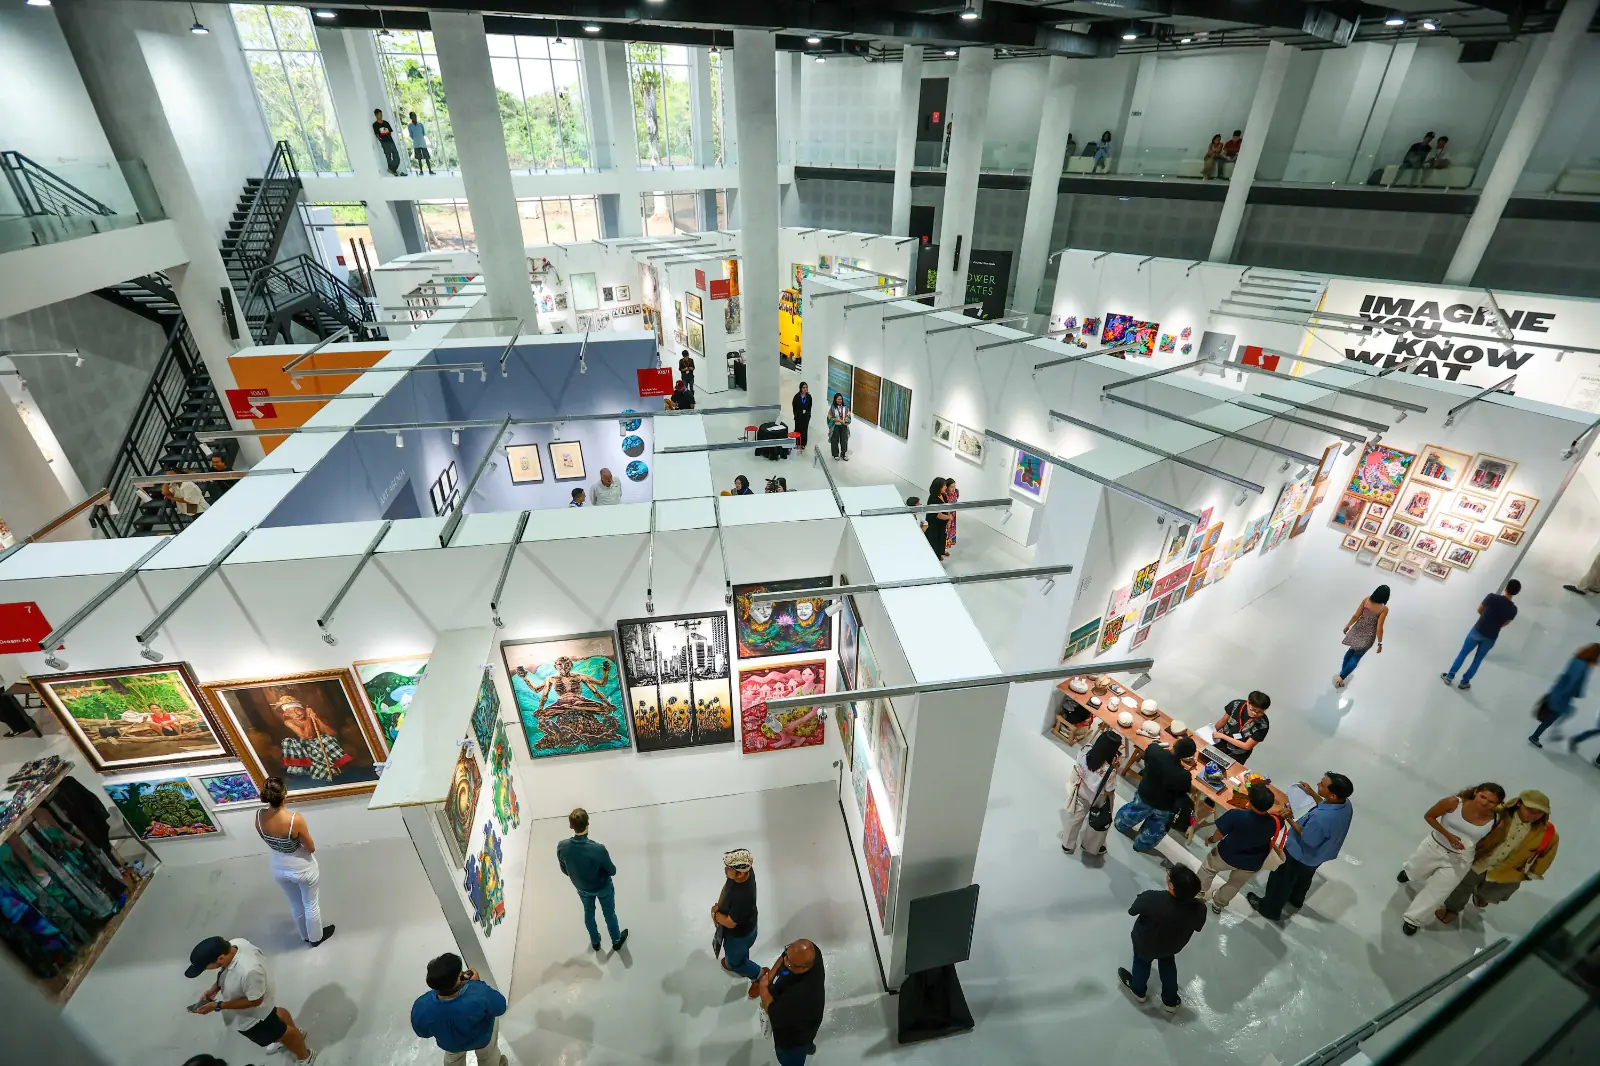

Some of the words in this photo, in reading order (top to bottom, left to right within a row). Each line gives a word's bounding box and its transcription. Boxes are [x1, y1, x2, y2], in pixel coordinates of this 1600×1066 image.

[966, 284, 993, 296] TATES
[967, 272, 996, 285] OWER
[1359, 294, 1556, 333] IMAGINE
[1345, 348, 1472, 382] WHAT
[1391, 337, 1535, 370] KNOW
[23, 605, 32, 614] 7
